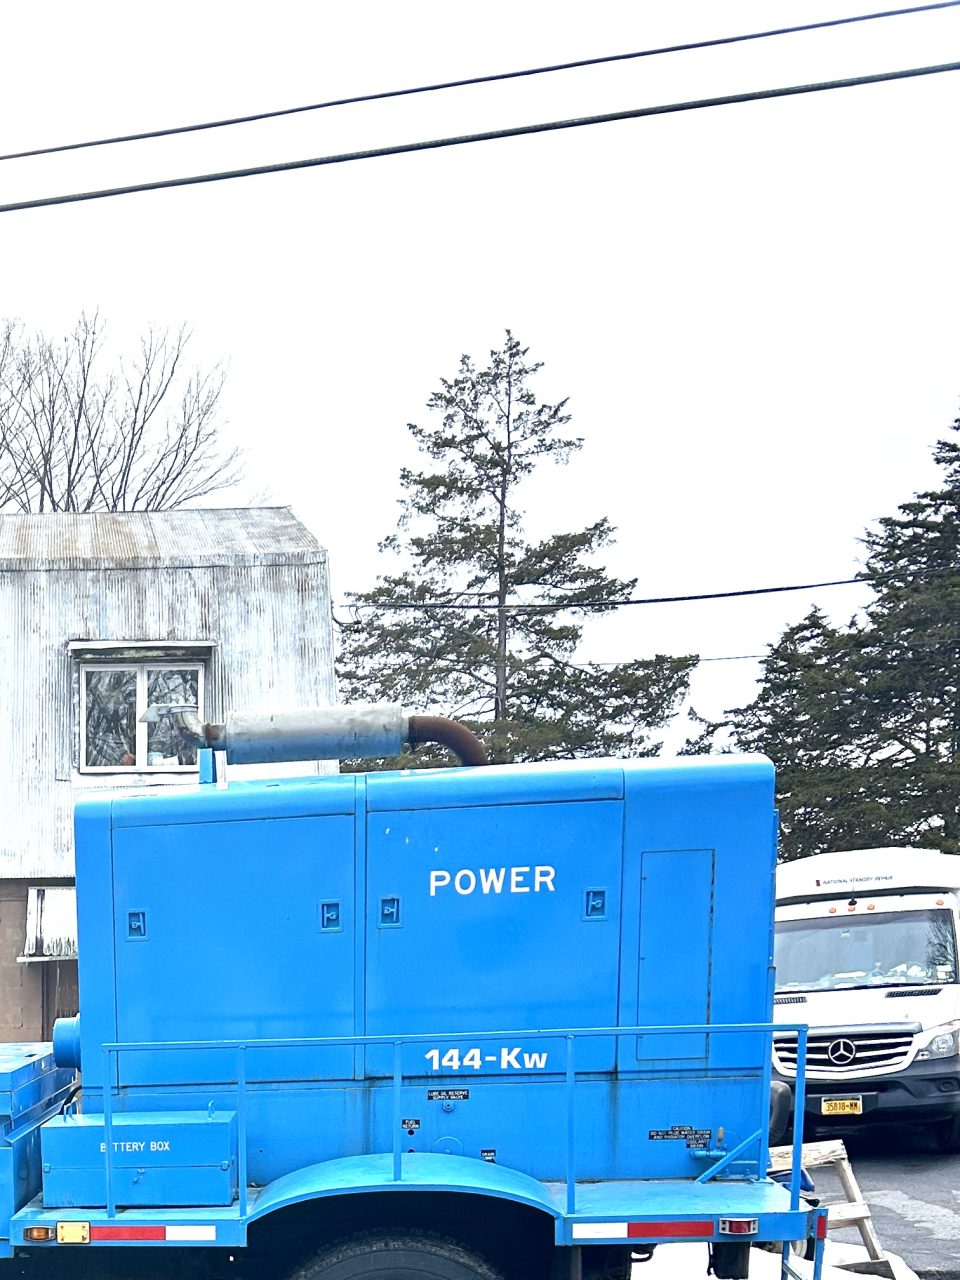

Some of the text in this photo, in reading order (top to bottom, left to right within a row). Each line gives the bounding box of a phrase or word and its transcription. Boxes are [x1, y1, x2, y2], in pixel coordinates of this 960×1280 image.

[429, 865, 556, 897] POWER
[424, 1047, 548, 1071] 144-Kw
[100, 1141, 170, 1152] BTTERY BOX
